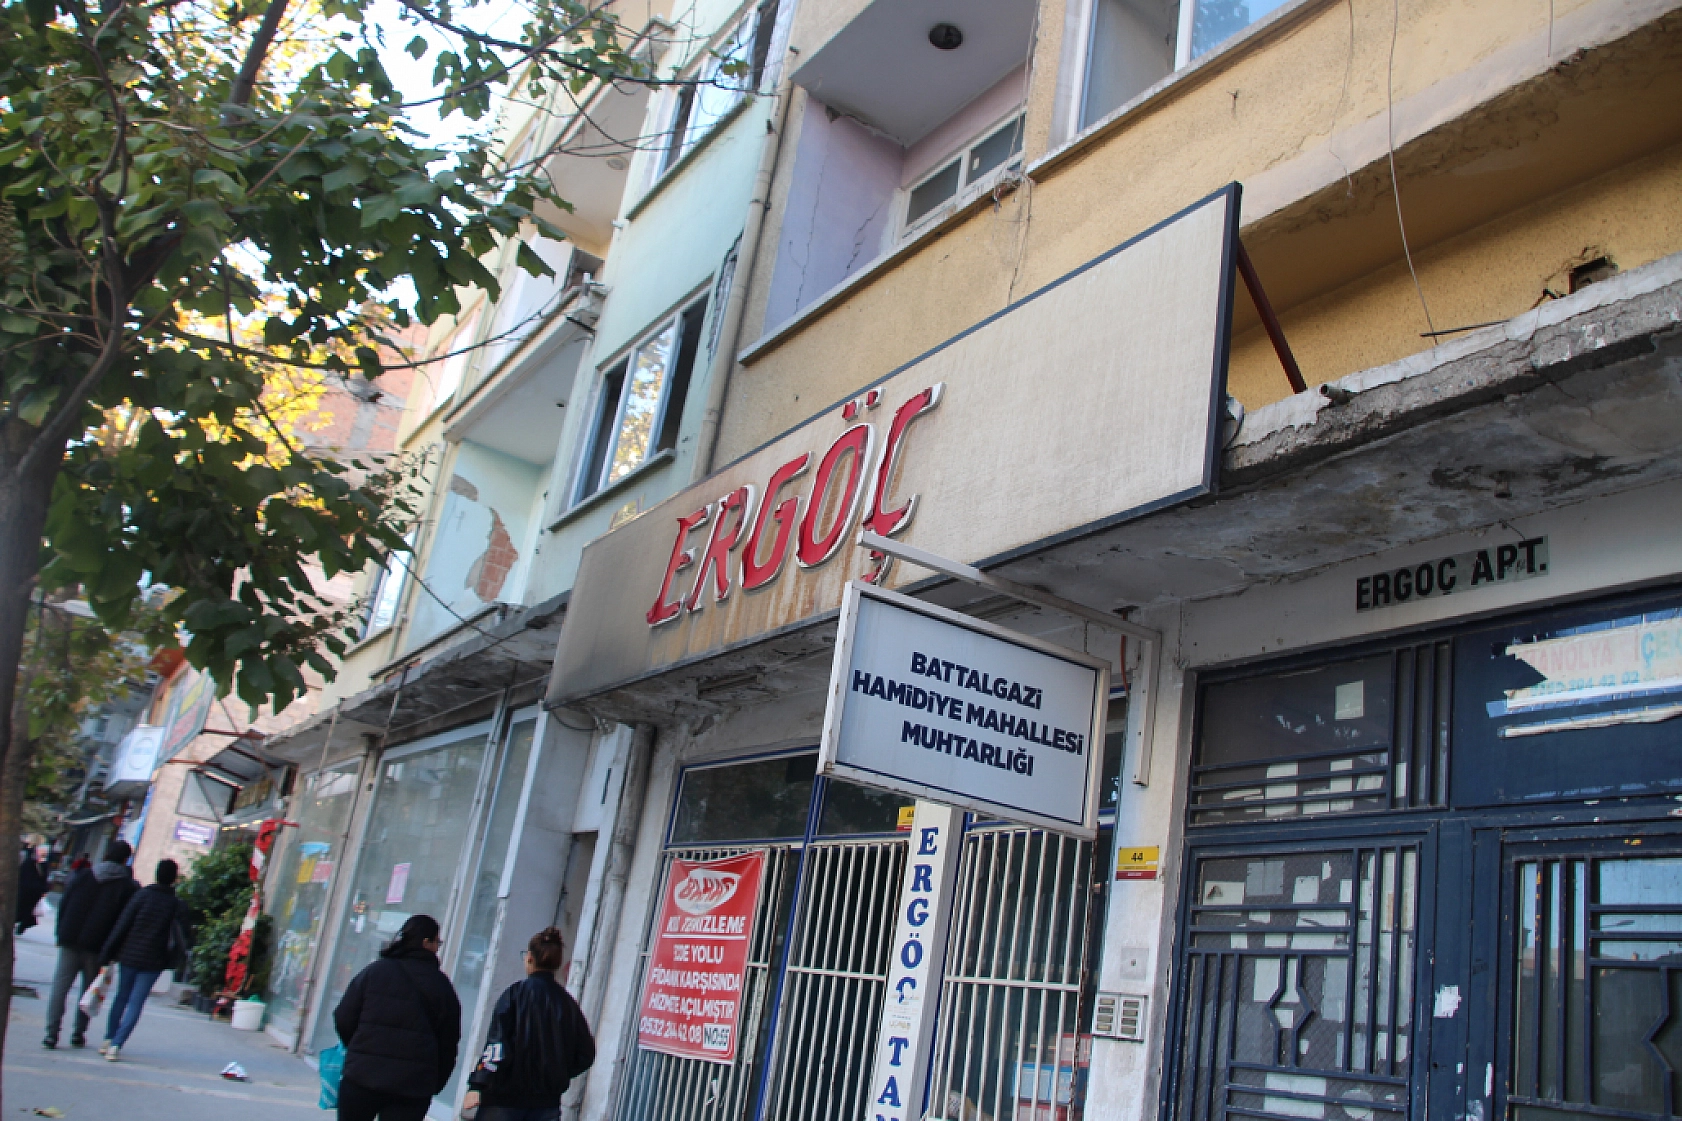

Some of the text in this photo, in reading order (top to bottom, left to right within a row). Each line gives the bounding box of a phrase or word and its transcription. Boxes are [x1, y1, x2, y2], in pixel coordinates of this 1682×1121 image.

[646, 382, 946, 627] ERGÖÇ
[1470, 537, 1547, 586] APT.
[901, 720, 1035, 776] MUHTARLIĞI
[895, 827, 939, 1003] ERGÖÇ
[691, 945, 724, 964] YOLU
[875, 1036, 910, 1121] TA
